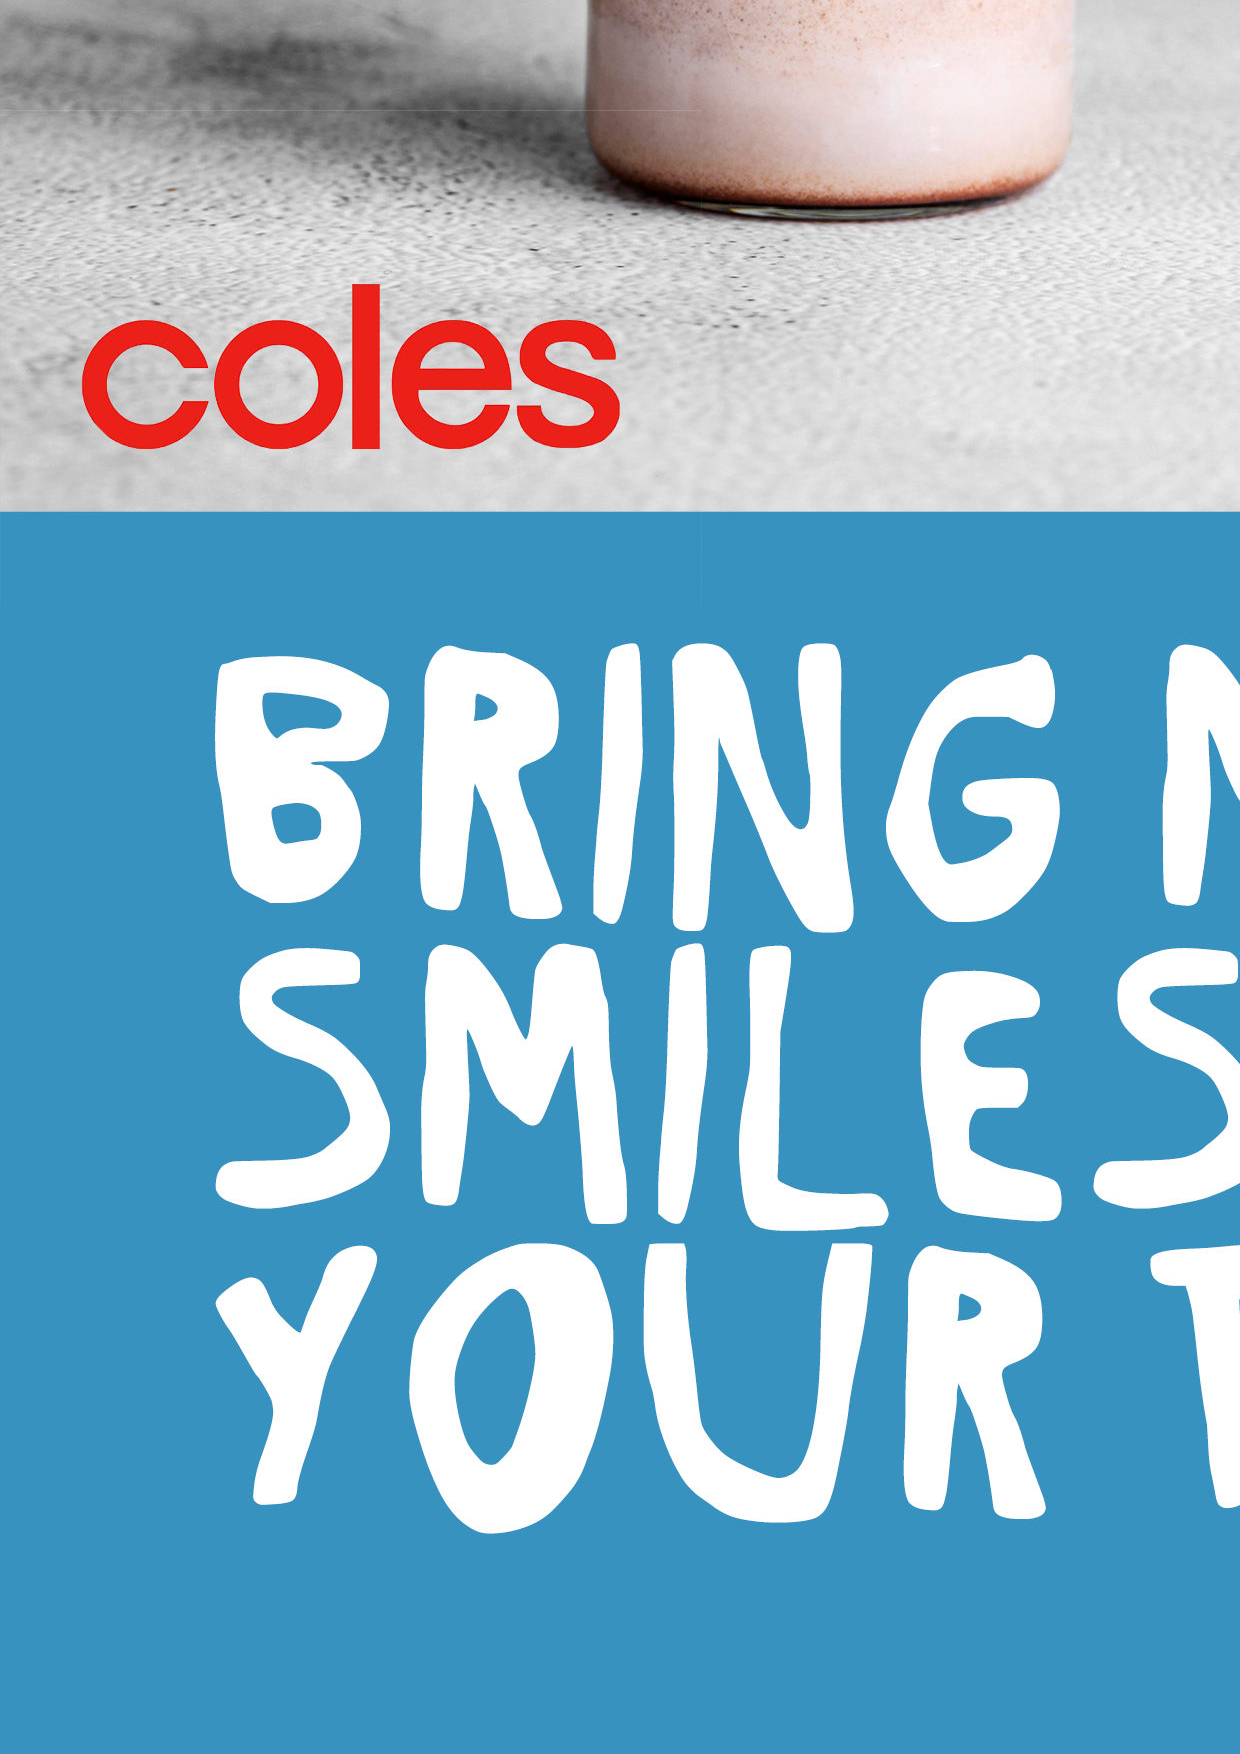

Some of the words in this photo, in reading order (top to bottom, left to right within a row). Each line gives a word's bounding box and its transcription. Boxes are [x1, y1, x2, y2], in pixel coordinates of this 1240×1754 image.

[81, 283, 621, 450] coles
[214, 643, 1061, 933] BRING
[215, 1243, 1047, 1534] YOUR
